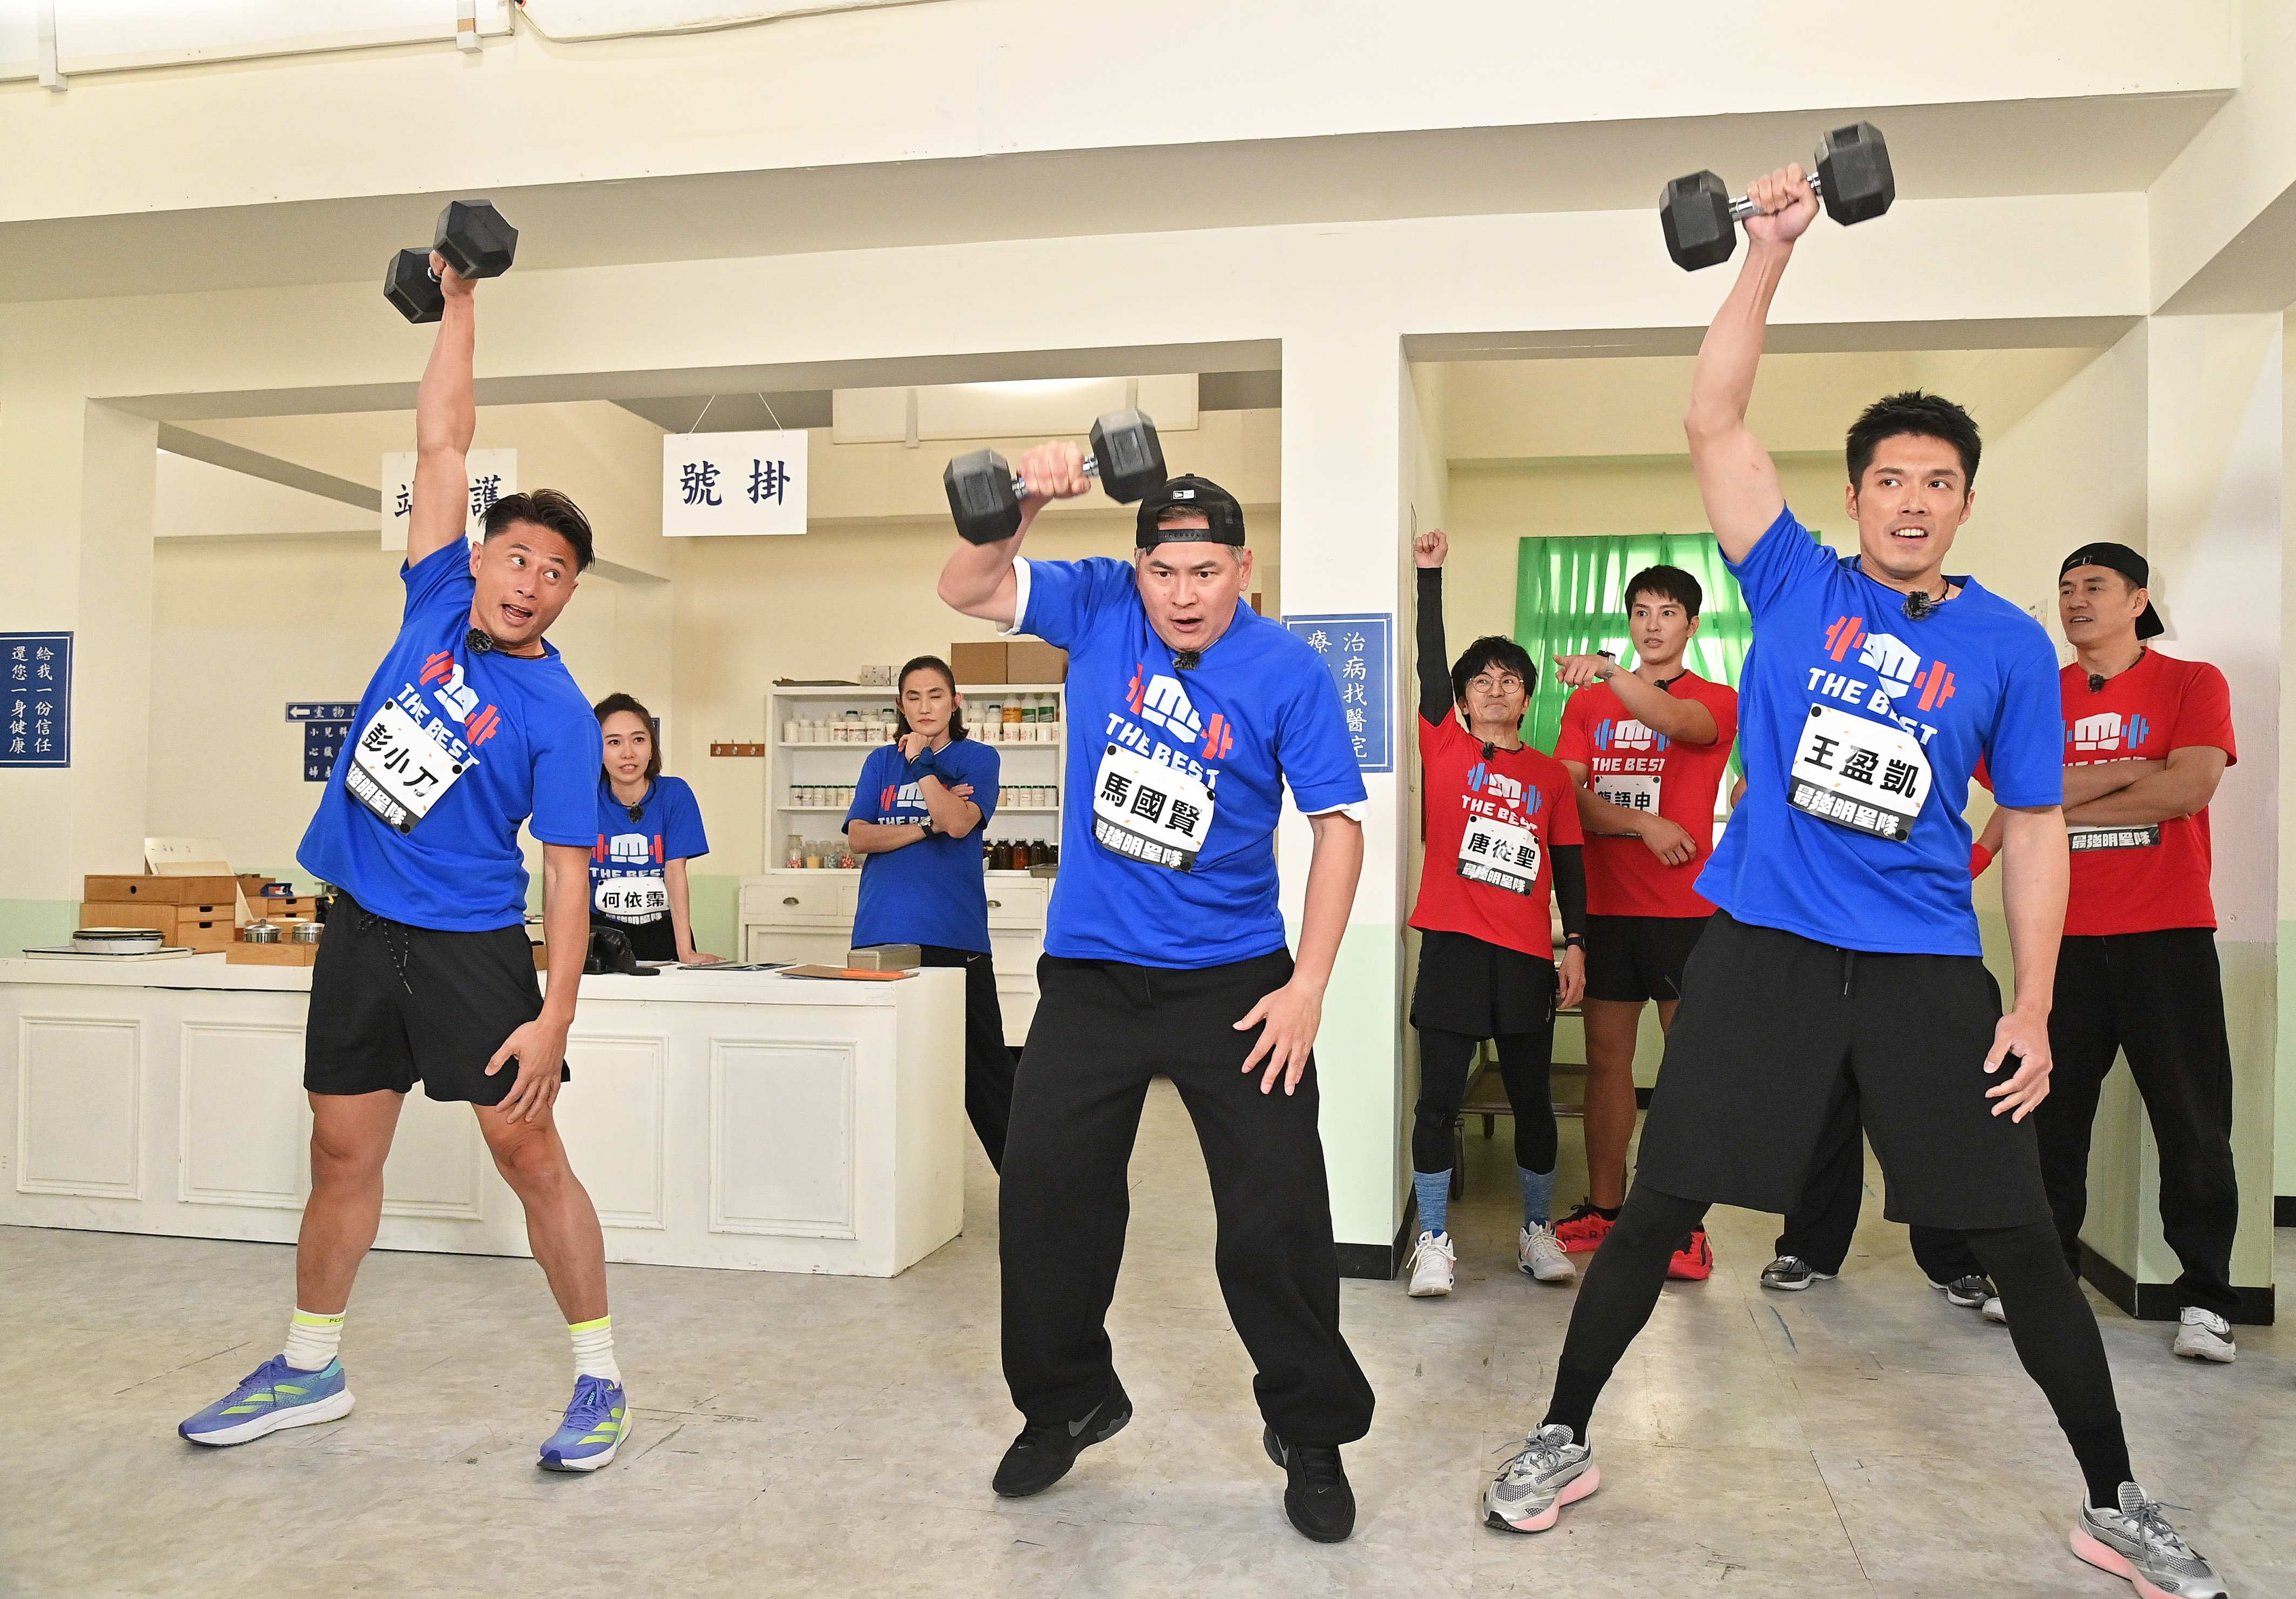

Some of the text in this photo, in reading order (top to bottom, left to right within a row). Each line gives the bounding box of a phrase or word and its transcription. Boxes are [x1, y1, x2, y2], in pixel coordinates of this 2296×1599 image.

[9, 646, 29, 754] 還您一身健康
[35, 646, 55, 753] 給我一份信任
[1807, 667, 1868, 704] THE
[397, 683, 480, 769] THE BEST
[309, 746, 342, 758] 心臟
[362, 723, 439, 797] 彭小刀
[1106, 712, 1220, 790] THE BEST
[1592, 758, 1666, 772] THE BEST
[1804, 734, 1919, 798] 王盈凱
[1100, 772, 1202, 838] 馬國賢
[1461, 794, 1496, 817] THE
[1793, 784, 1900, 835] 最強明星隊
[1096, 818, 1183, 867] 最強明星隊
[1468, 832, 1536, 869] 唐從聖
[2072, 831, 2151, 849] 最強明星隊
[589, 867, 665, 878] THE BES
[1462, 862, 1525, 893] 最強明星隊
